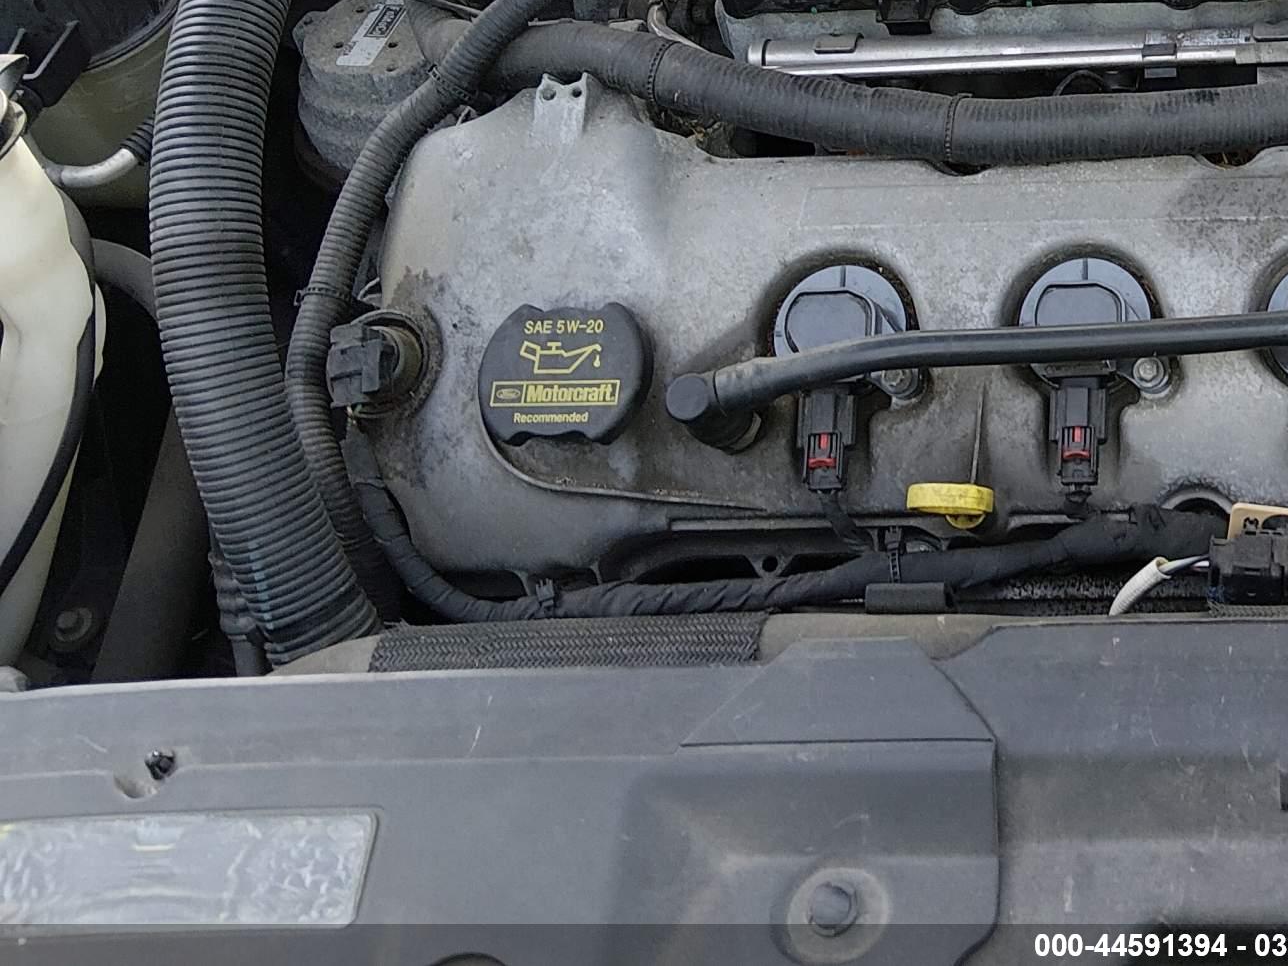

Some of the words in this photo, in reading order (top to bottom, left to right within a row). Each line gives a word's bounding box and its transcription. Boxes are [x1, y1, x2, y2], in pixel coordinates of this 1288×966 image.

[524, 320, 553, 334] SAE
[556, 319, 604, 334] 5W-20
[513, 411, 589, 423] Recommended
